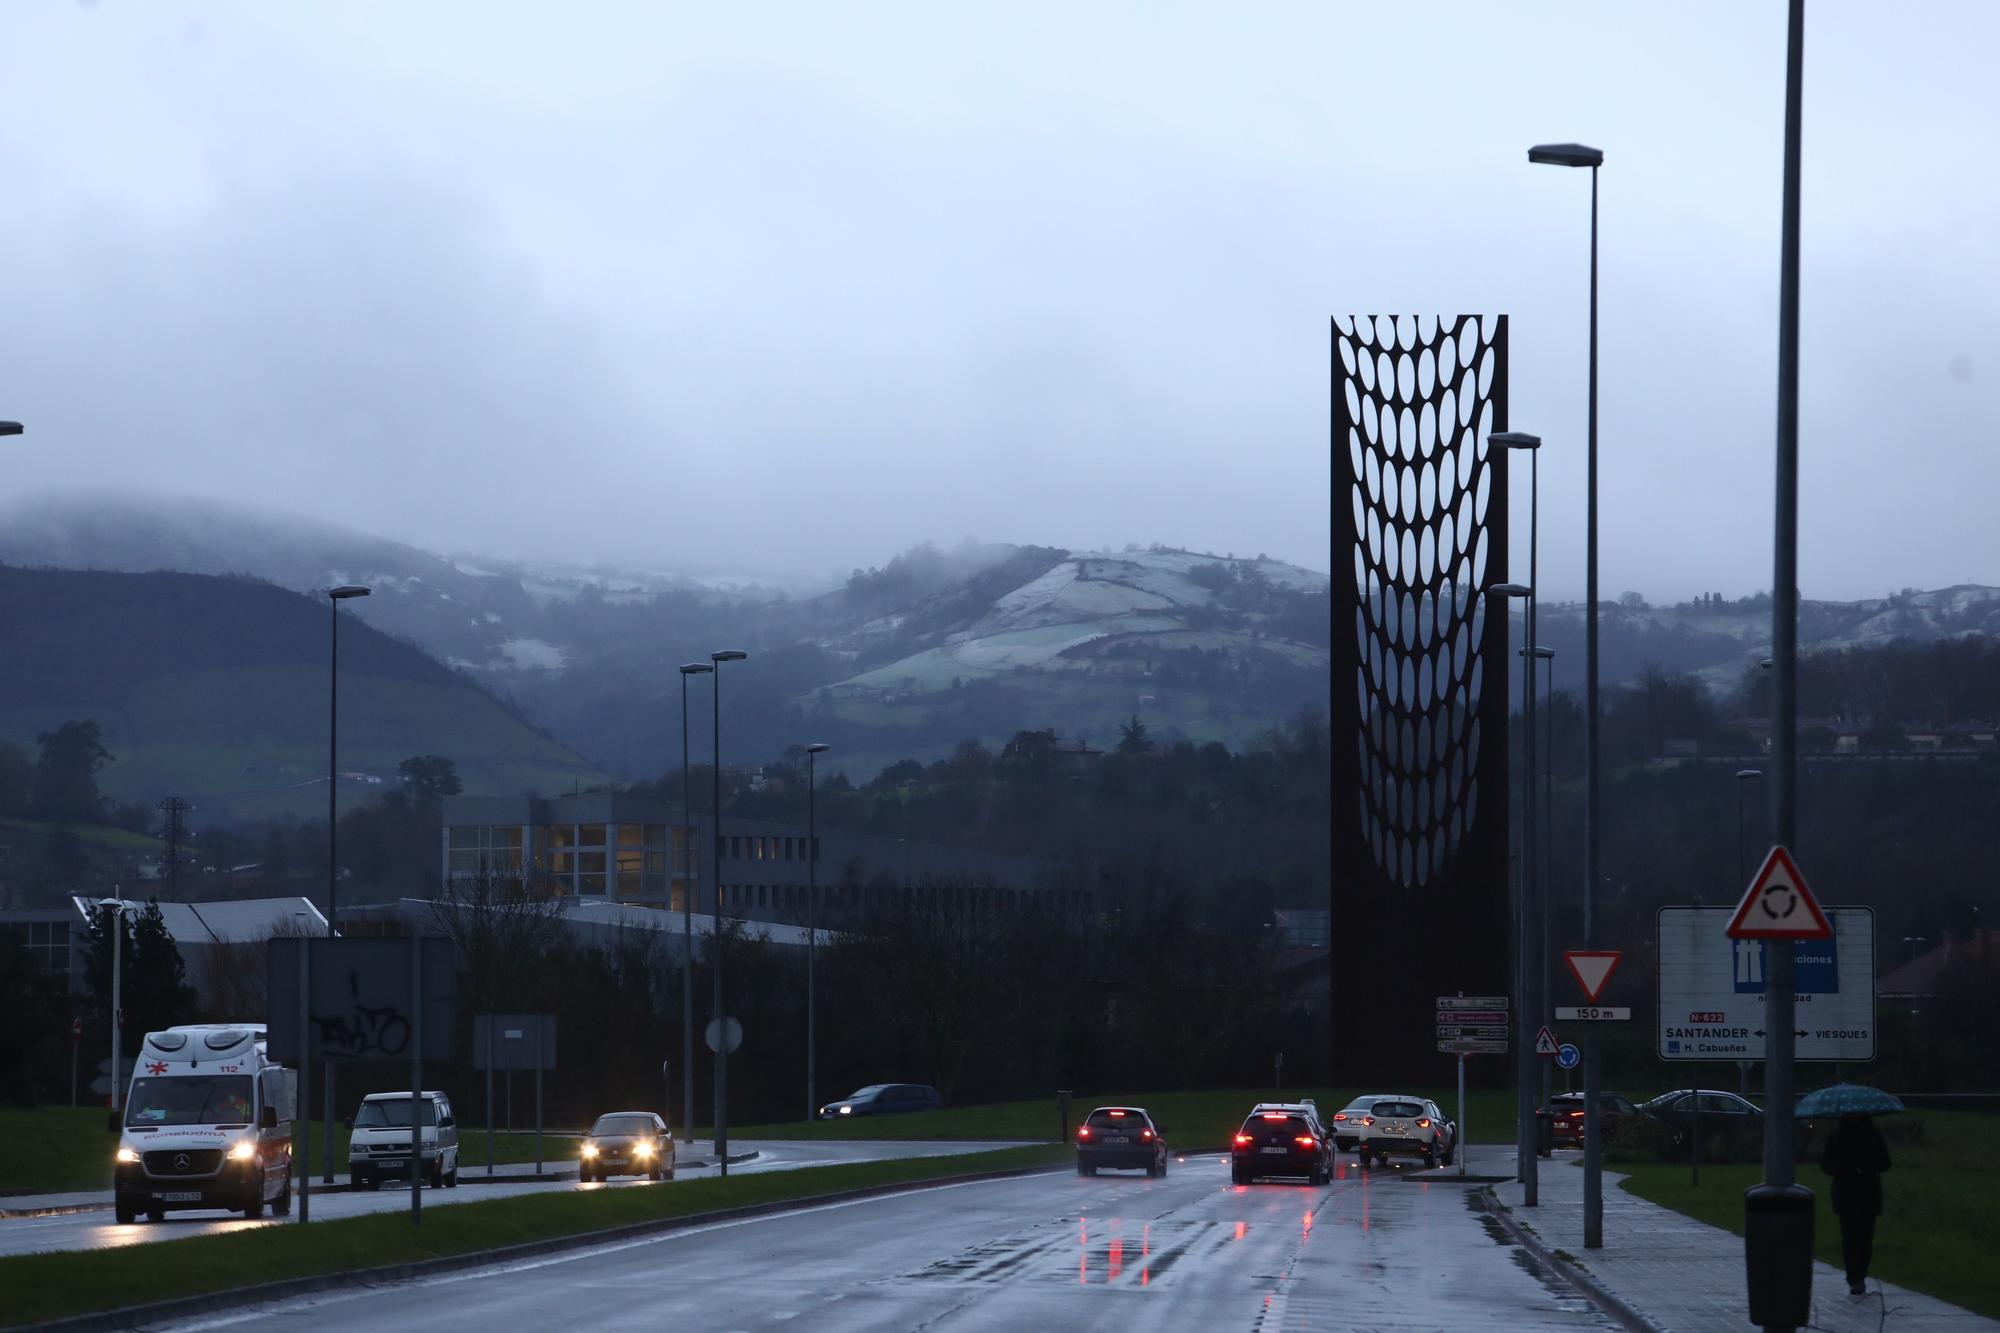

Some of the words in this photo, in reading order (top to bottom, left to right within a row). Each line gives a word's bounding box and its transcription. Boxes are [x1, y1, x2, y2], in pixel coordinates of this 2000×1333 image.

[1576, 1009, 1599, 1018] 150
[1666, 1028, 1748, 1038] SANTANDER
[1815, 1030, 1868, 1039] VIESQUES
[1698, 1043, 1747, 1052] Cabueñes
[219, 1065, 239, 1073] 112
